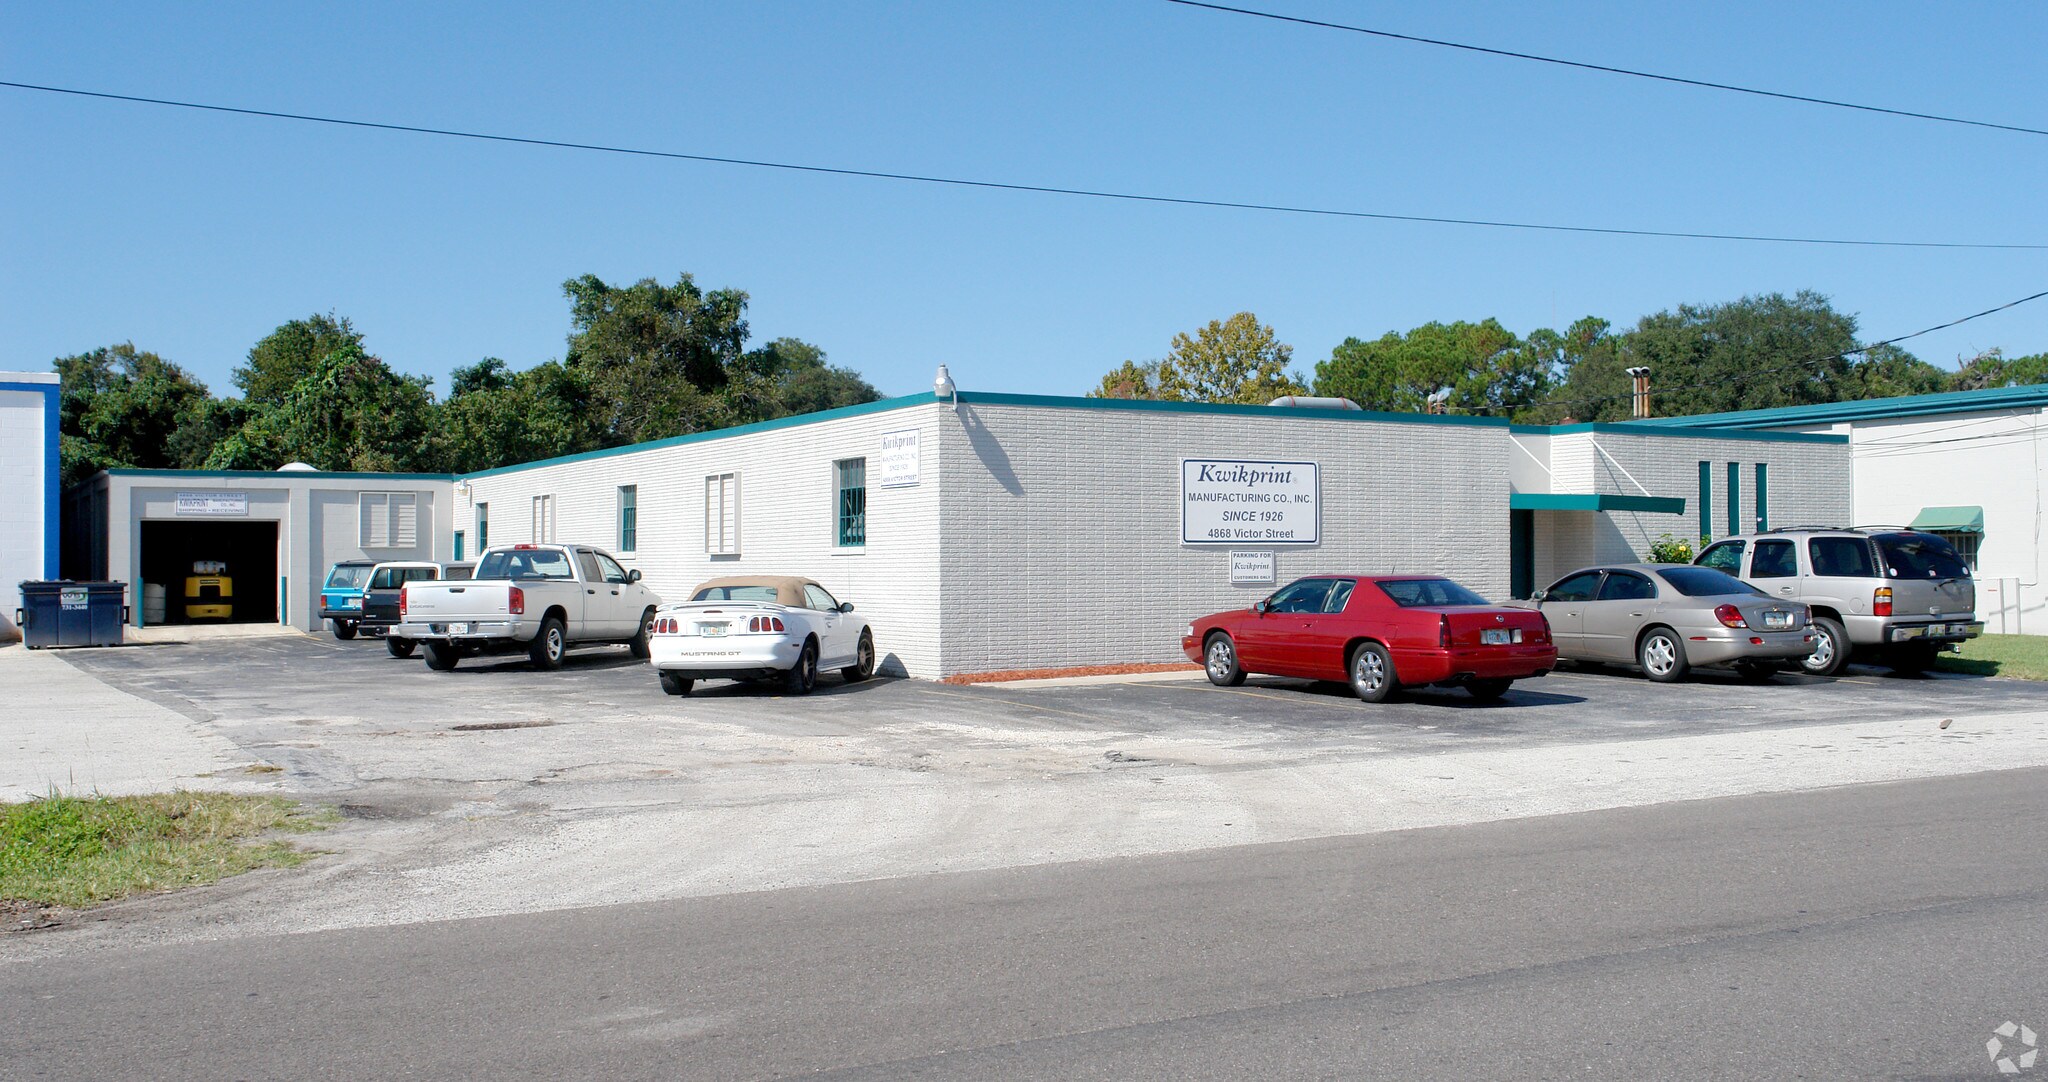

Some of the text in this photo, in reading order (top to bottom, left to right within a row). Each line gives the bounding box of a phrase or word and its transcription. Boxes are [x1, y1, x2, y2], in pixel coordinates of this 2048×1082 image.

[1197, 464, 1292, 487] Kwikprint
[1188, 492, 1313, 504] MANUFACTURING CO., INC.
[1222, 511, 1284, 522] SINCE 1926
[1207, 528, 1294, 538] 4868 Victor Street
[1234, 562, 1270, 571] Kwikprint
